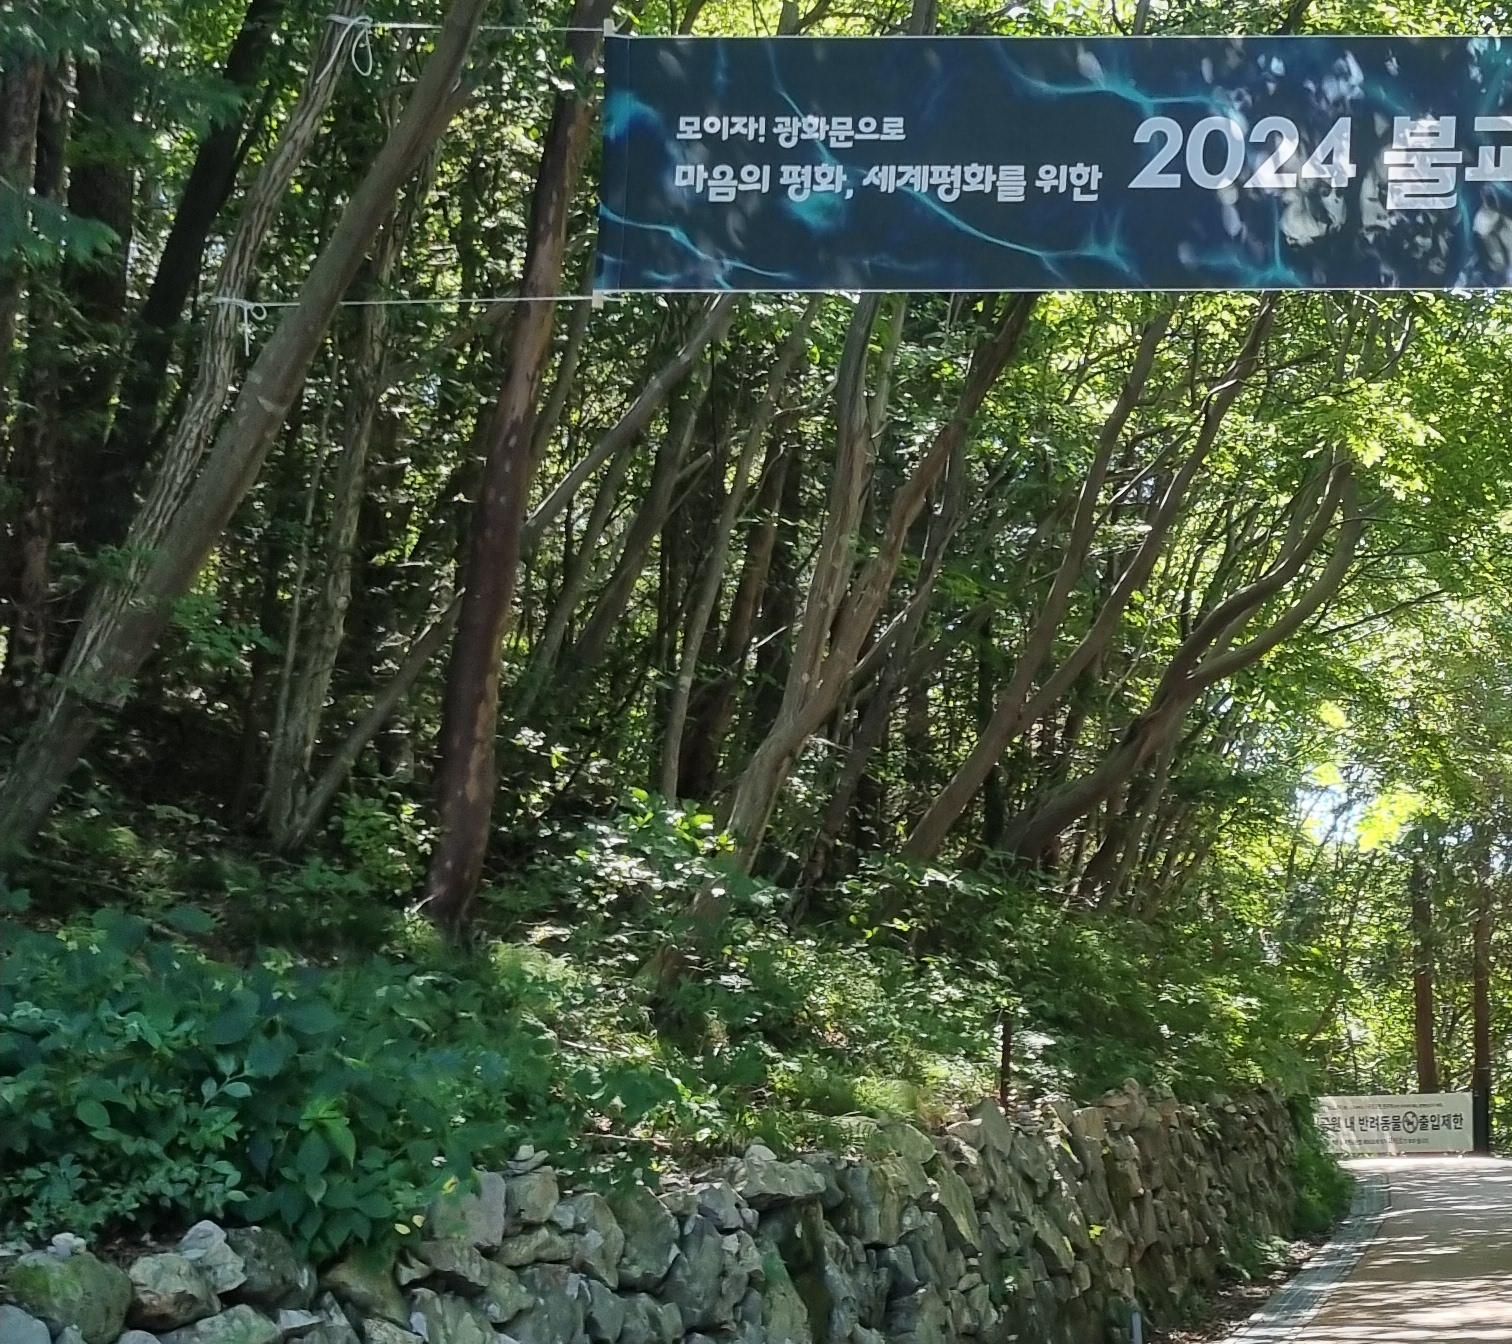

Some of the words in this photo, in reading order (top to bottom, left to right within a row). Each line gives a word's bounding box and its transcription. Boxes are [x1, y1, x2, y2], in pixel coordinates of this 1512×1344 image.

[676, 116, 766, 143] 모이자!
[773, 115, 906, 148] 광화문으로
[1127, 116, 1357, 190] 2024
[674, 164, 771, 203] 마음의
[779, 163, 853, 203] 평화,
[862, 163, 1027, 203] 세계평화를
[1035, 163, 1103, 202] 위한
[1344, 1115, 1355, 1132] 내
[1358, 1115, 1401, 1132] 반려동물
[1419, 1113, 1463, 1131] 출입제한
